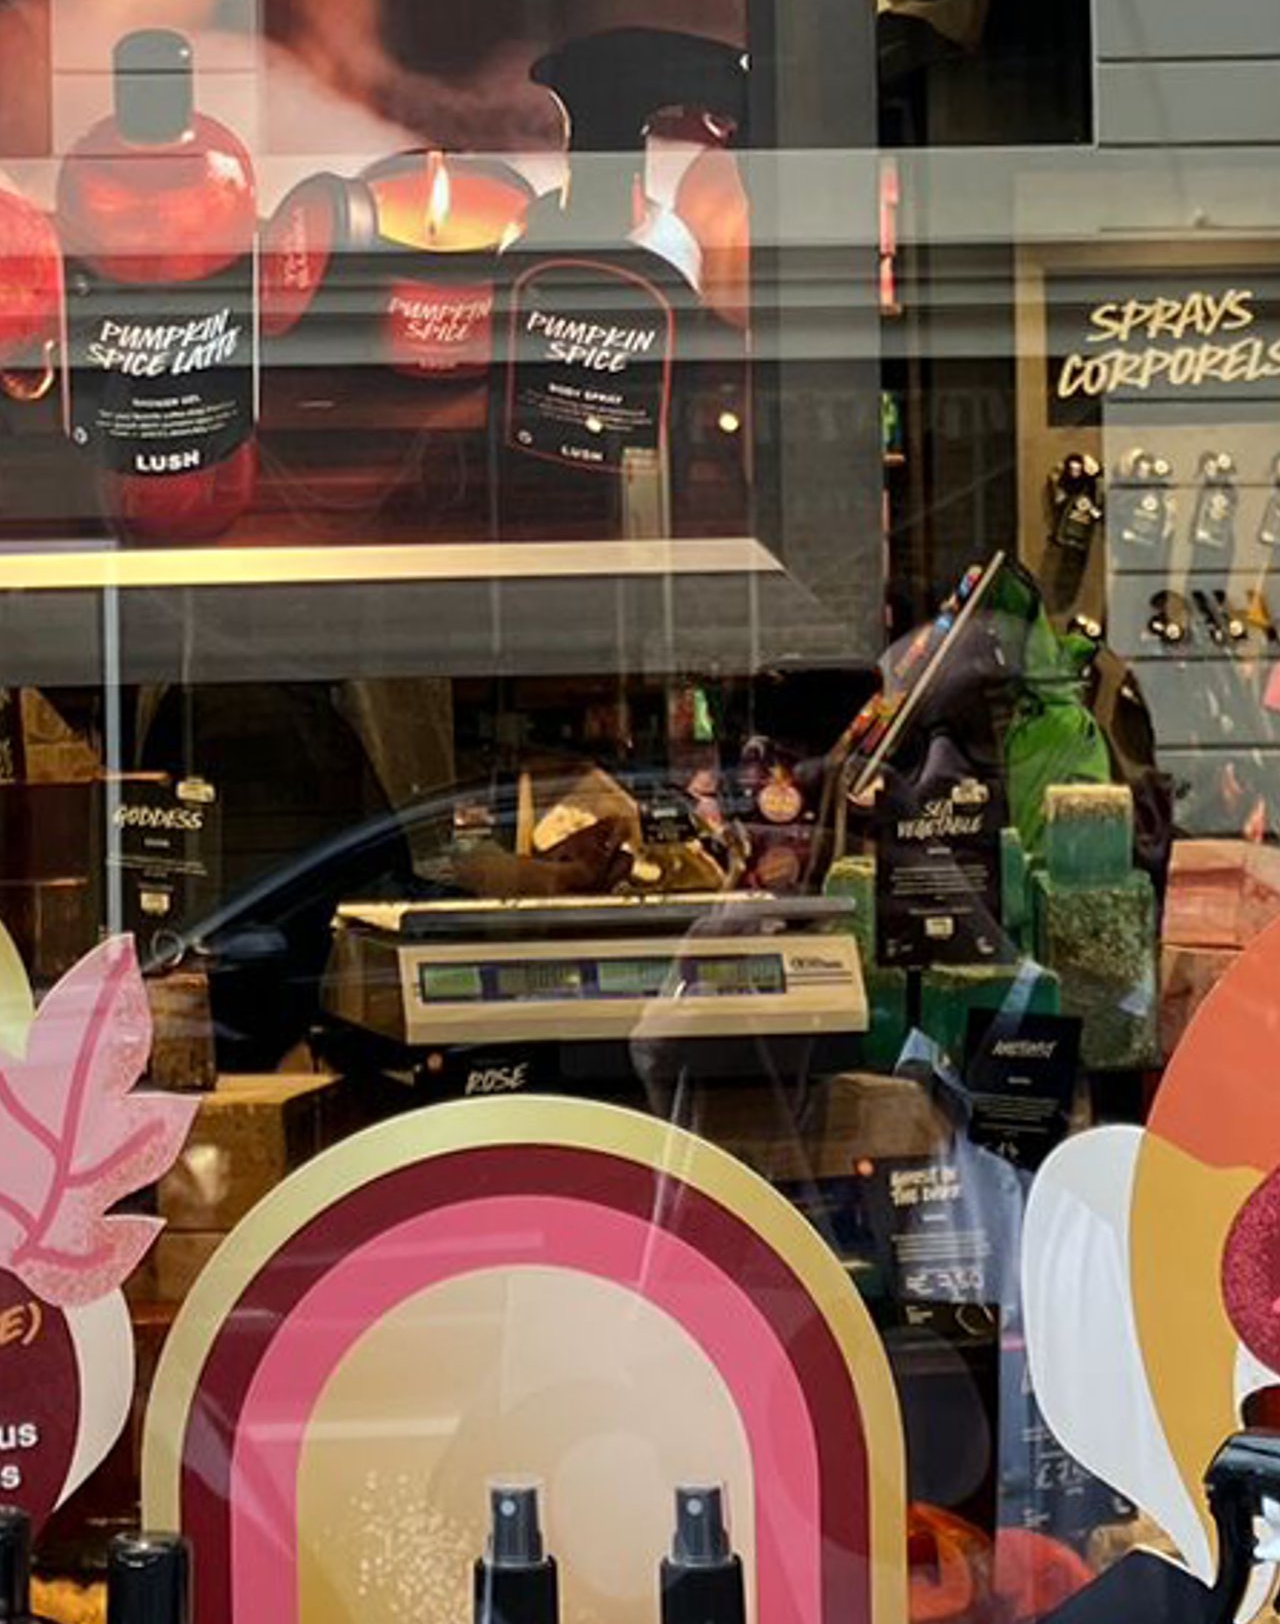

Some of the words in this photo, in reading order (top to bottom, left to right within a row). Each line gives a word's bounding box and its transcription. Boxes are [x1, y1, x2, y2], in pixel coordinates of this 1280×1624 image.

[388, 297, 494, 320] PUMPKIN
[1086, 288, 1253, 342] SPRAYS
[100, 309, 230, 350] PUMPKIN
[406, 322, 470, 343] SPICE
[526, 311, 655, 351] PUMPKIN
[87, 343, 169, 376] SPICE
[172, 326, 241, 374] LATTE
[545, 342, 629, 373] SPICE
[136, 449, 200, 471] LUSH
[561, 445, 603, 462] LUSH
[112, 805, 203, 830] GODDESS
